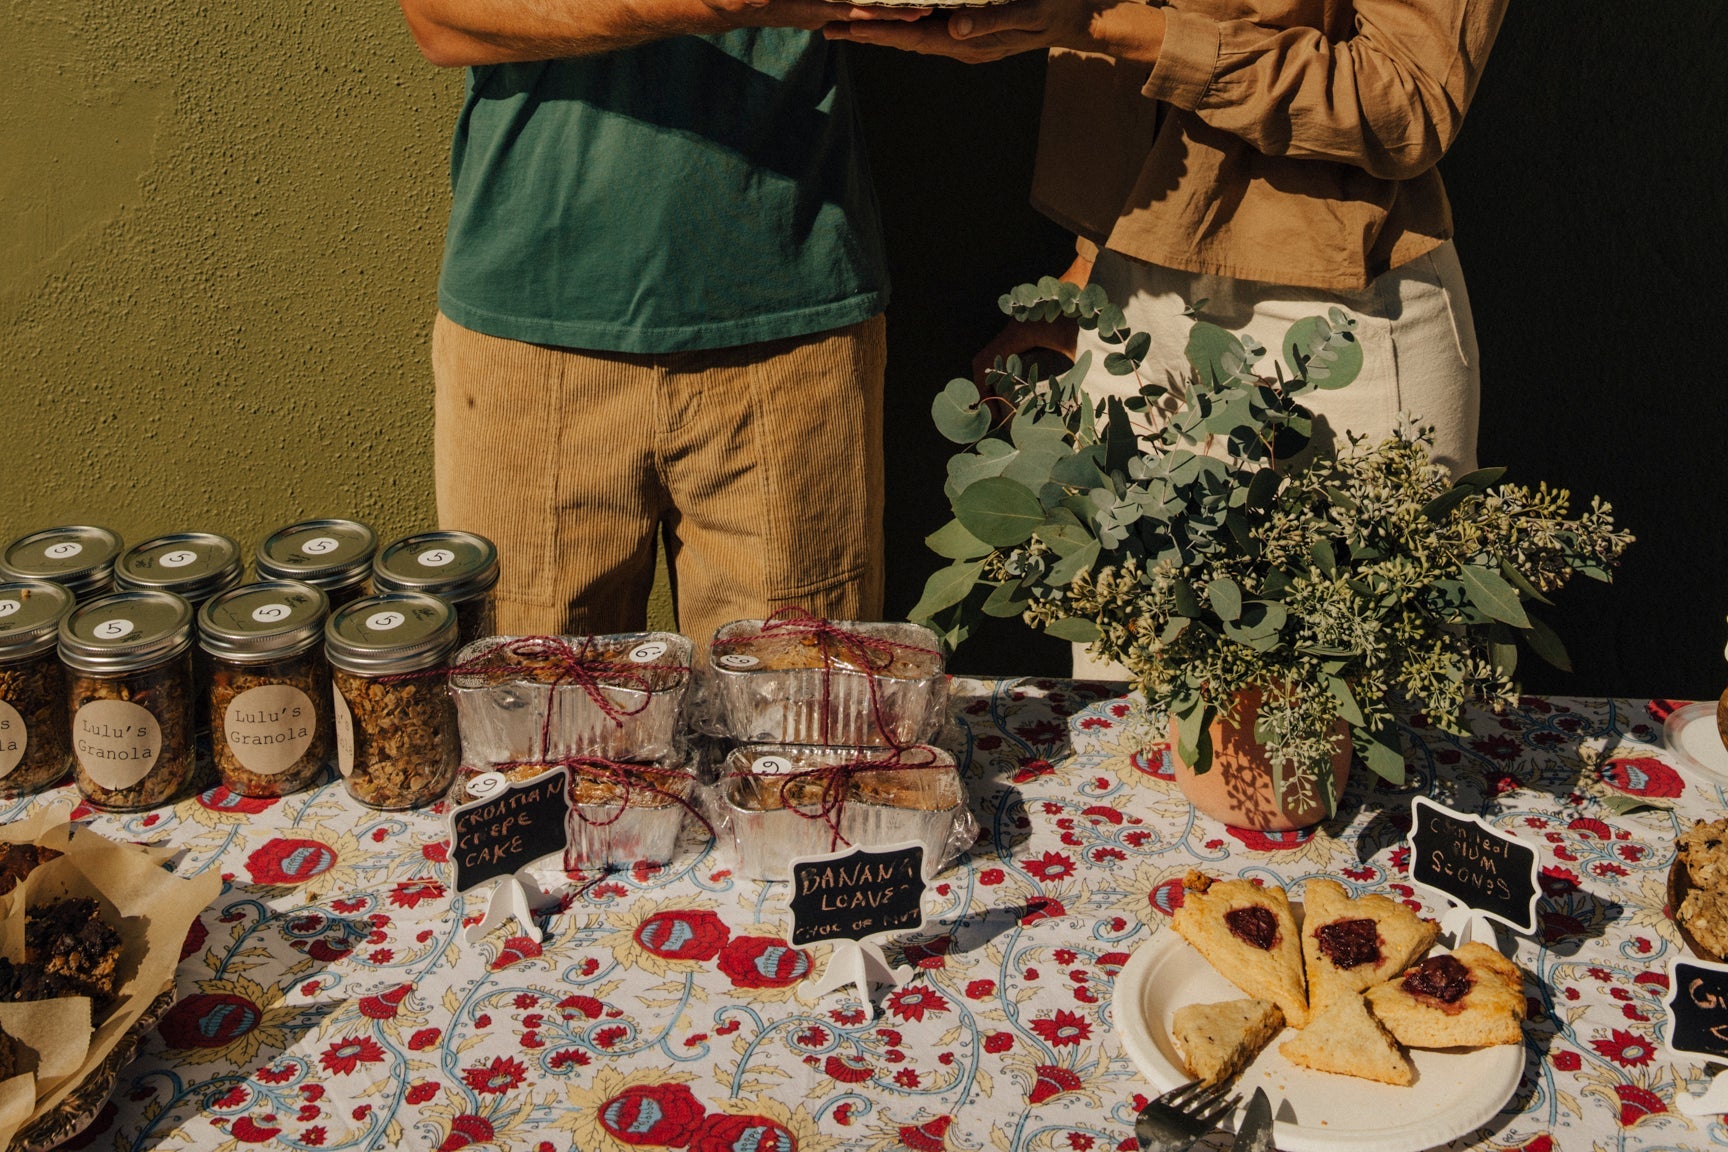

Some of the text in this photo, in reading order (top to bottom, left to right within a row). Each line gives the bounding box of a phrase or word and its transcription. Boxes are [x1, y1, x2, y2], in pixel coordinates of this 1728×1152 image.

[54, 544, 76, 554] 5
[308, 540, 334, 551] 5
[169, 553, 191, 563] 5
[427, 551, 448, 562] 5
[259, 608, 281, 617] 5
[375, 615, 397, 626] 5
[106, 622, 122, 634] 5
[235, 706, 301, 724] Lulu's
[82, 719, 147, 738] Lulu's
[230, 727, 308, 745] Granola
[78, 739, 152, 760] Granola
[458, 778, 564, 833] CROATIAN
[465, 835, 522, 867] CAKE
